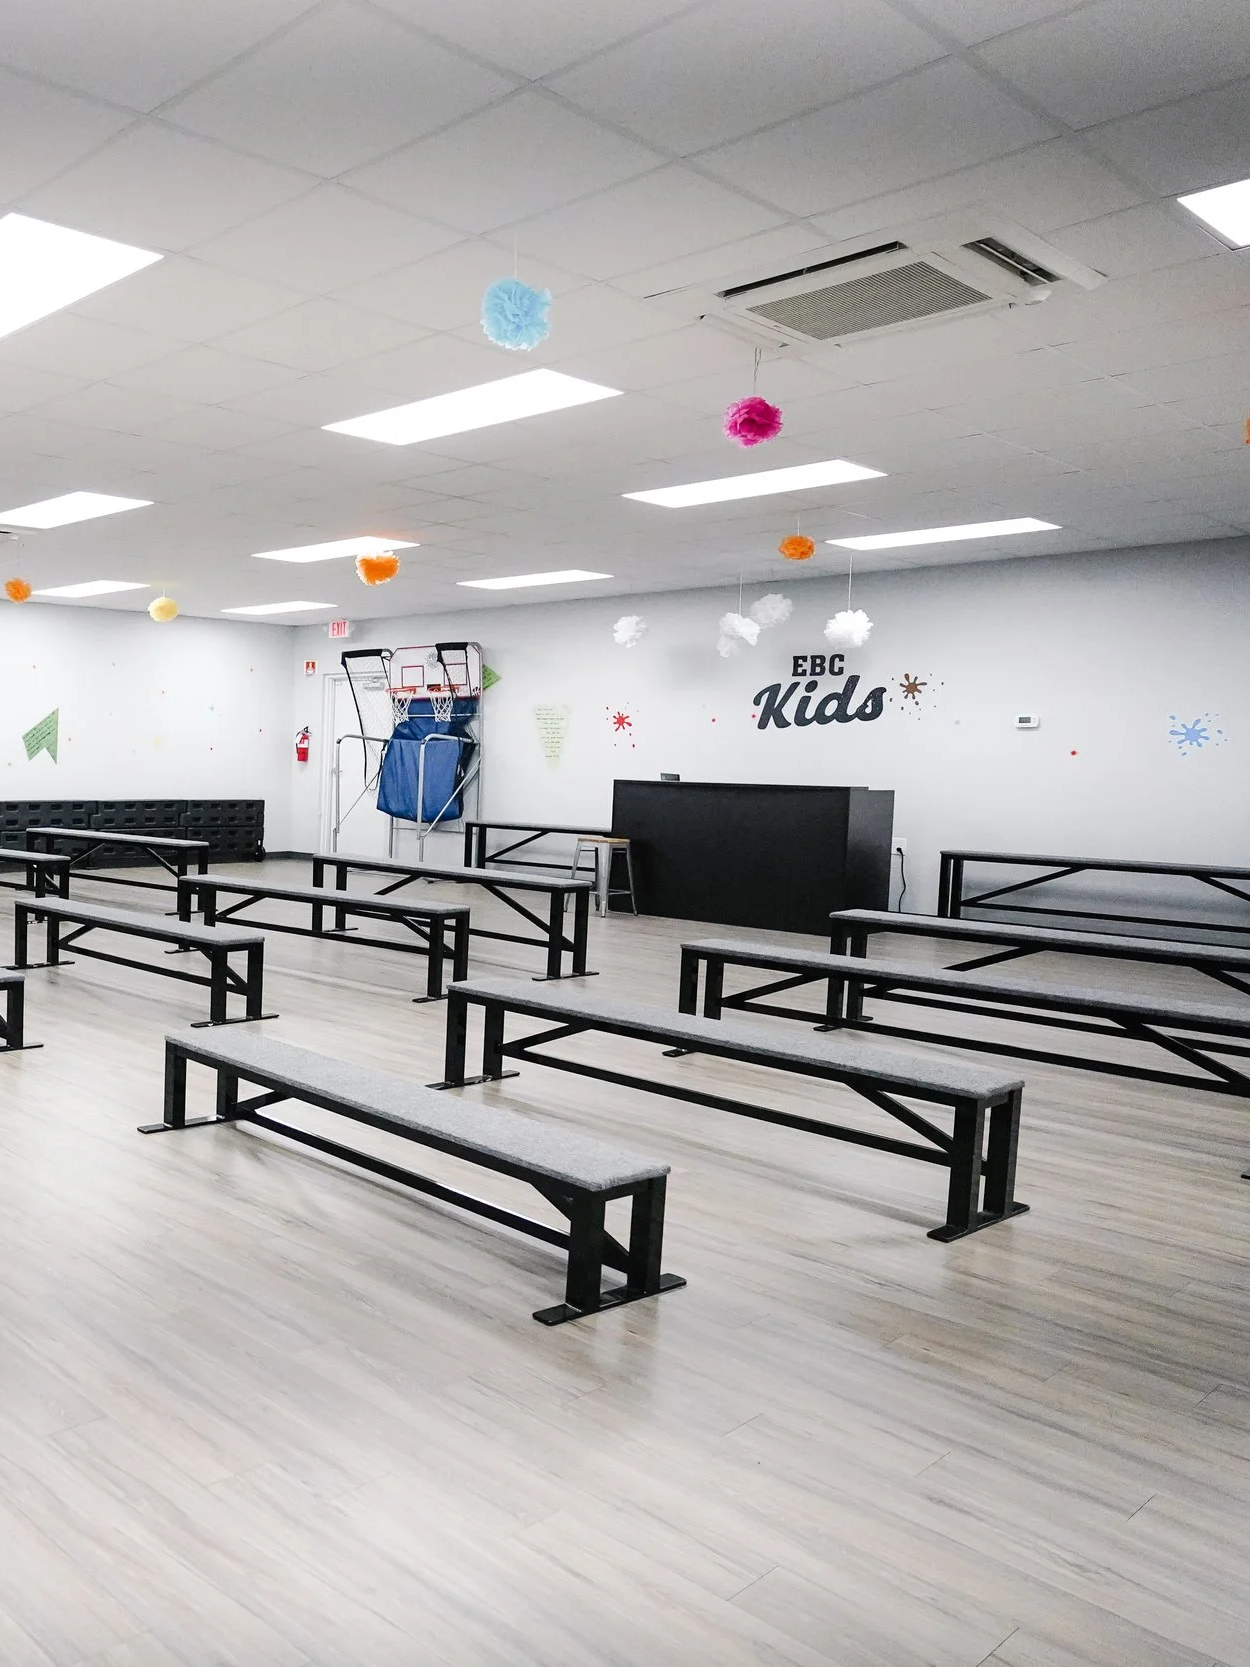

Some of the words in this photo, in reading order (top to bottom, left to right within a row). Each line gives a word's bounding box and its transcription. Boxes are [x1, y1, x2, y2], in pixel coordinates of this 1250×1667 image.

[332, 621, 347, 637] EXIT
[791, 653, 845, 677] EBC
[752, 674, 887, 730] Kids
